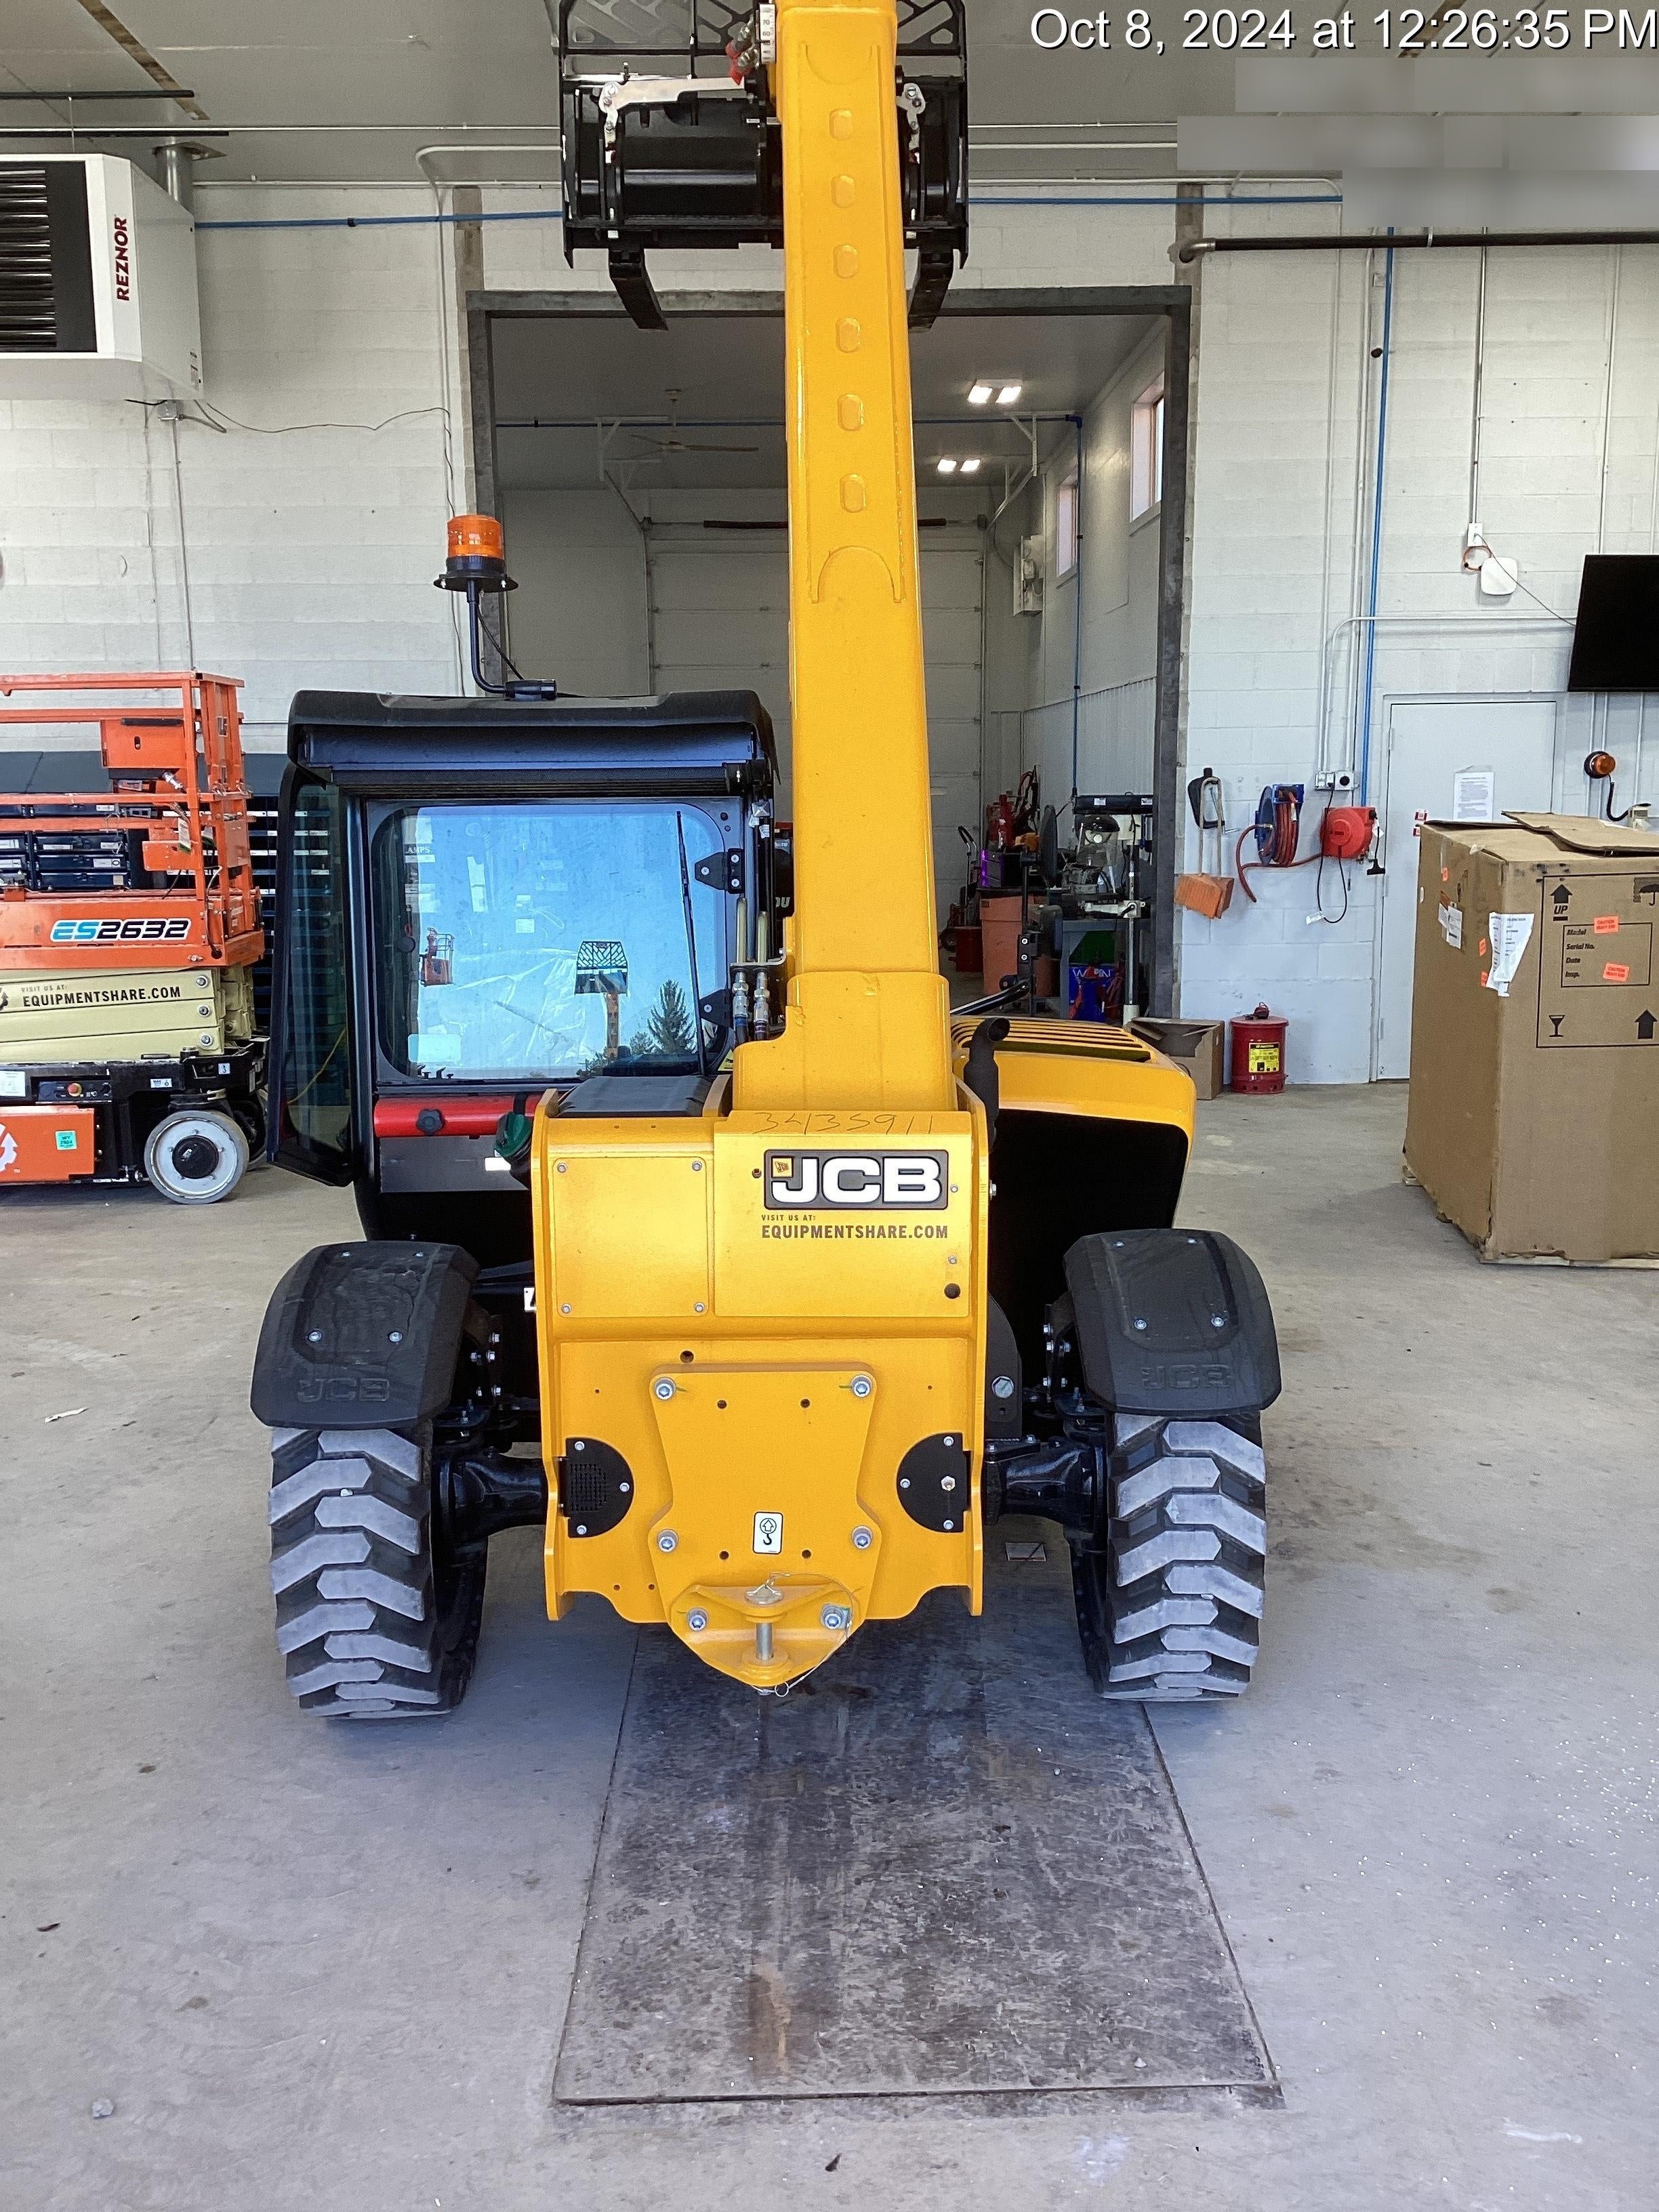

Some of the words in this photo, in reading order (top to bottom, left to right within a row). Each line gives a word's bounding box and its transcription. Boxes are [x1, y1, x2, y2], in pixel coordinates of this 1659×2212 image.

[114, 216, 129, 301] REZNOR
[1553, 905, 1568, 915] UP
[52, 920, 190, 941] ES2632
[22, 986, 182, 1007] EQUIPMENTSHARE.COM
[771, 1155, 942, 1204] JCB
[761, 1225, 948, 1239] EQUIPMENTSHARE.COM
[297, 1378, 390, 1402] JCB
